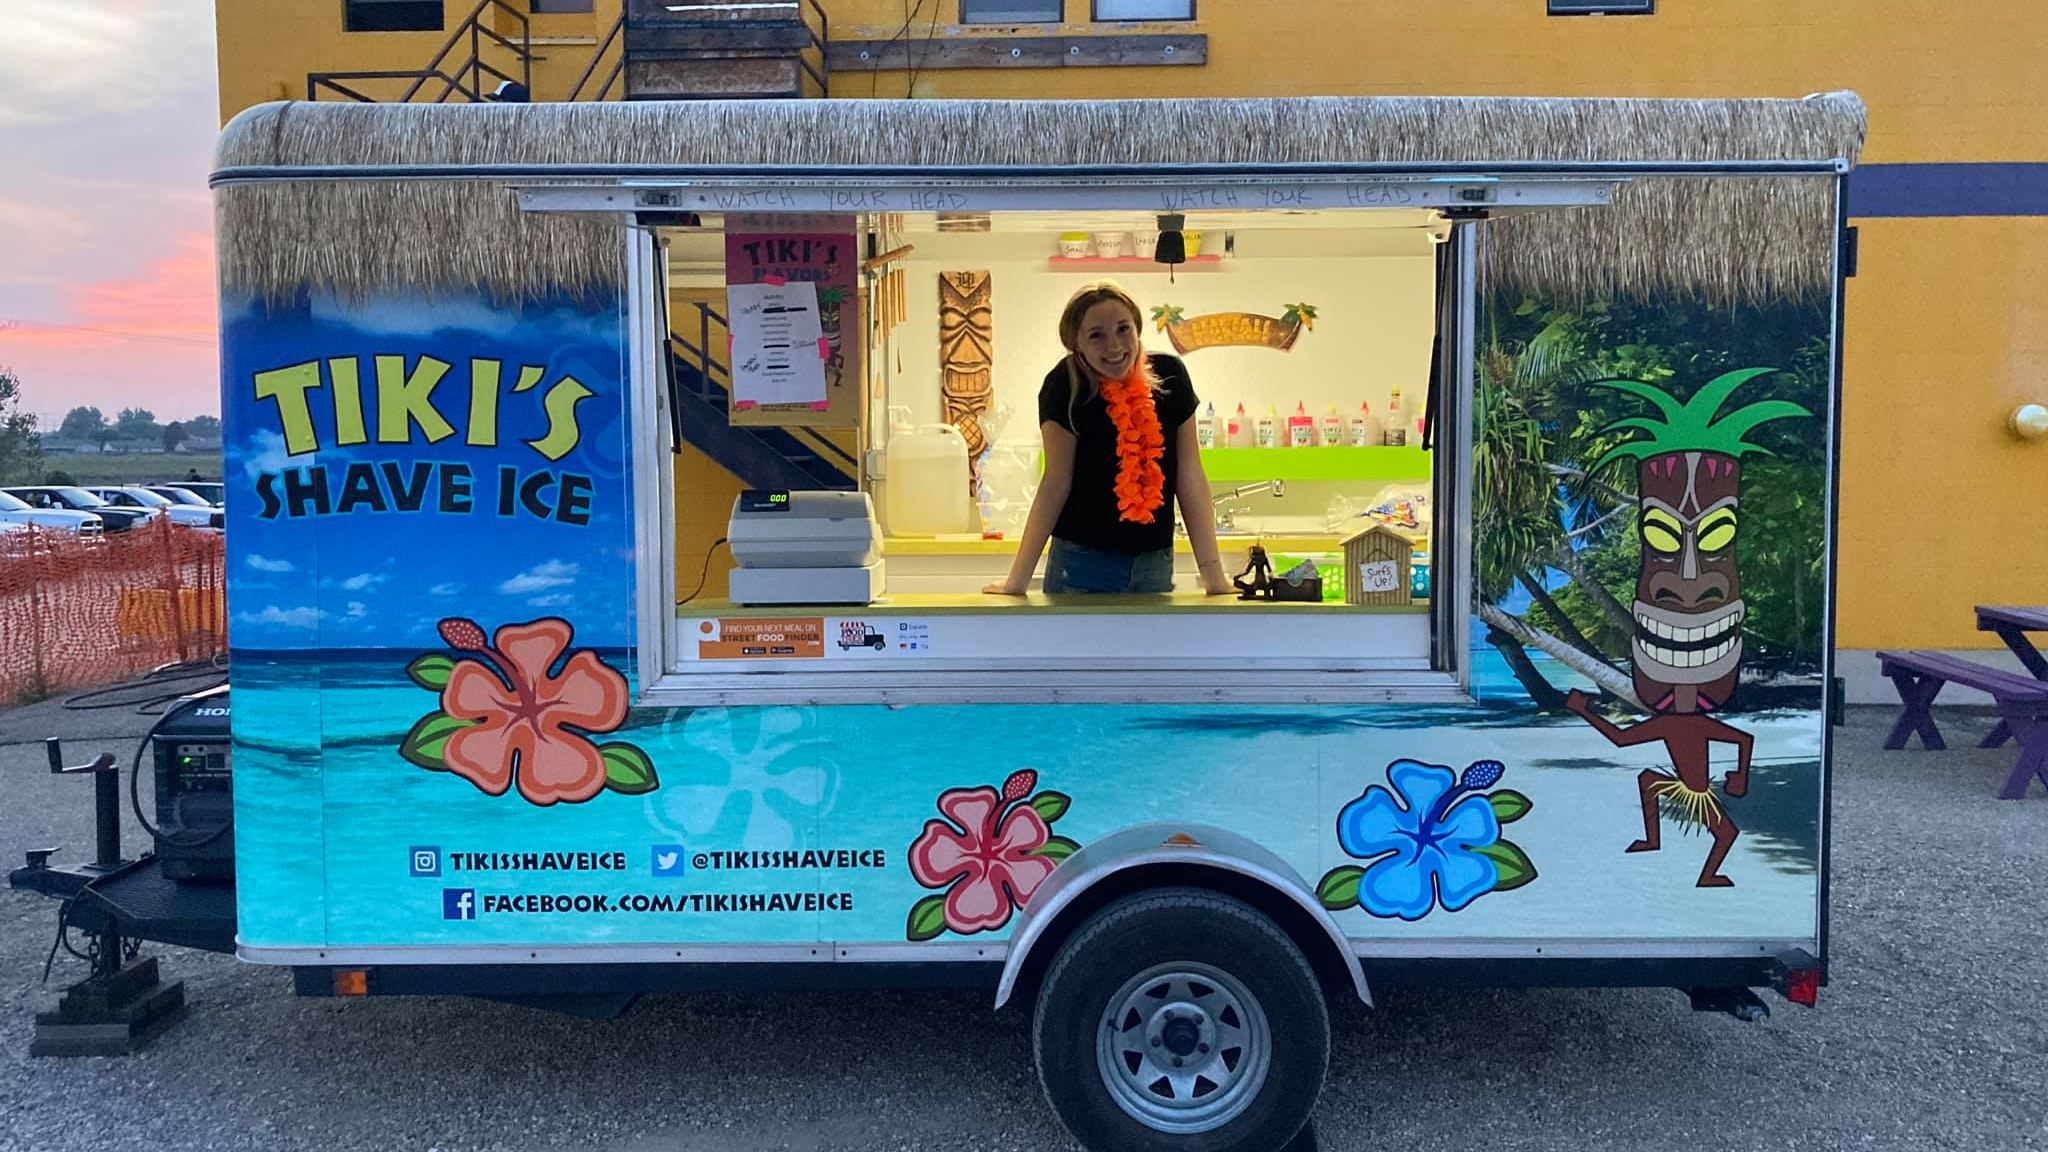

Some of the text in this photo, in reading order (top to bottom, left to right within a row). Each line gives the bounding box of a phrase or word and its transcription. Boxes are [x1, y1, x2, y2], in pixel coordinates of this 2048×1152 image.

[713, 189, 968, 210] WATCH YOUR HEAD
[1160, 189, 1238, 209] WATCH
[1346, 187, 1412, 204] HEAD
[743, 239, 838, 265] TIKI'S
[254, 353, 597, 461] TIKI'S
[256, 462, 594, 526] SHAVE ICE
[725, 624, 817, 633] FIND YOUR NEXT MEAL ON
[450, 851, 627, 871] TIKISSHAVEICE
[691, 849, 886, 871] @TIKISSHAVEICE
[483, 892, 854, 914] FACEBOOK.COM/TIKISHAVEICE
